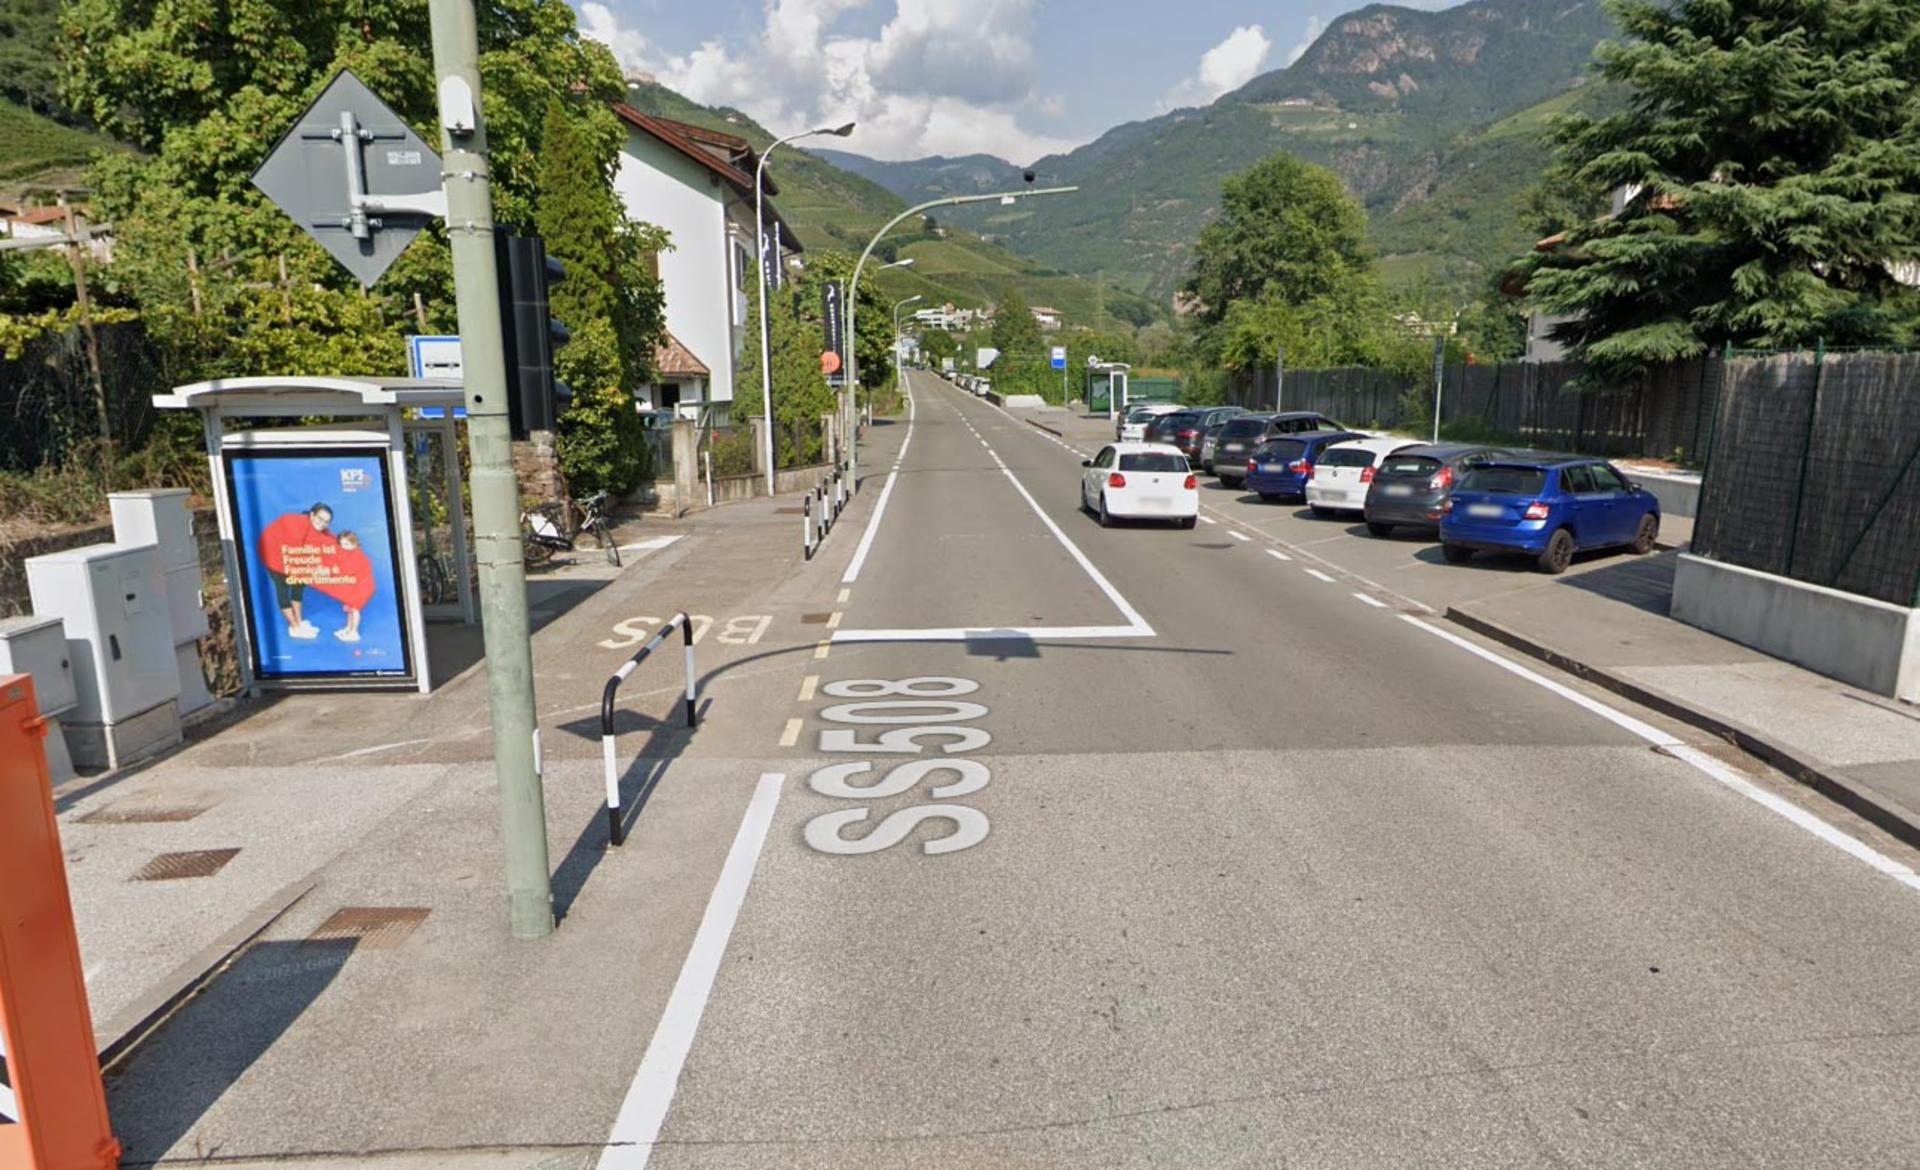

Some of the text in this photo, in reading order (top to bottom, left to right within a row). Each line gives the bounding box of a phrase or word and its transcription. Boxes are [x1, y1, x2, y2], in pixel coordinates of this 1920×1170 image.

[281, 545, 336, 555] Familie ist
[282, 555, 322, 564] Freude
[284, 565, 330, 576] Famiglia
[285, 575, 357, 585] divertimento
[595, 614, 773, 650] BUS
